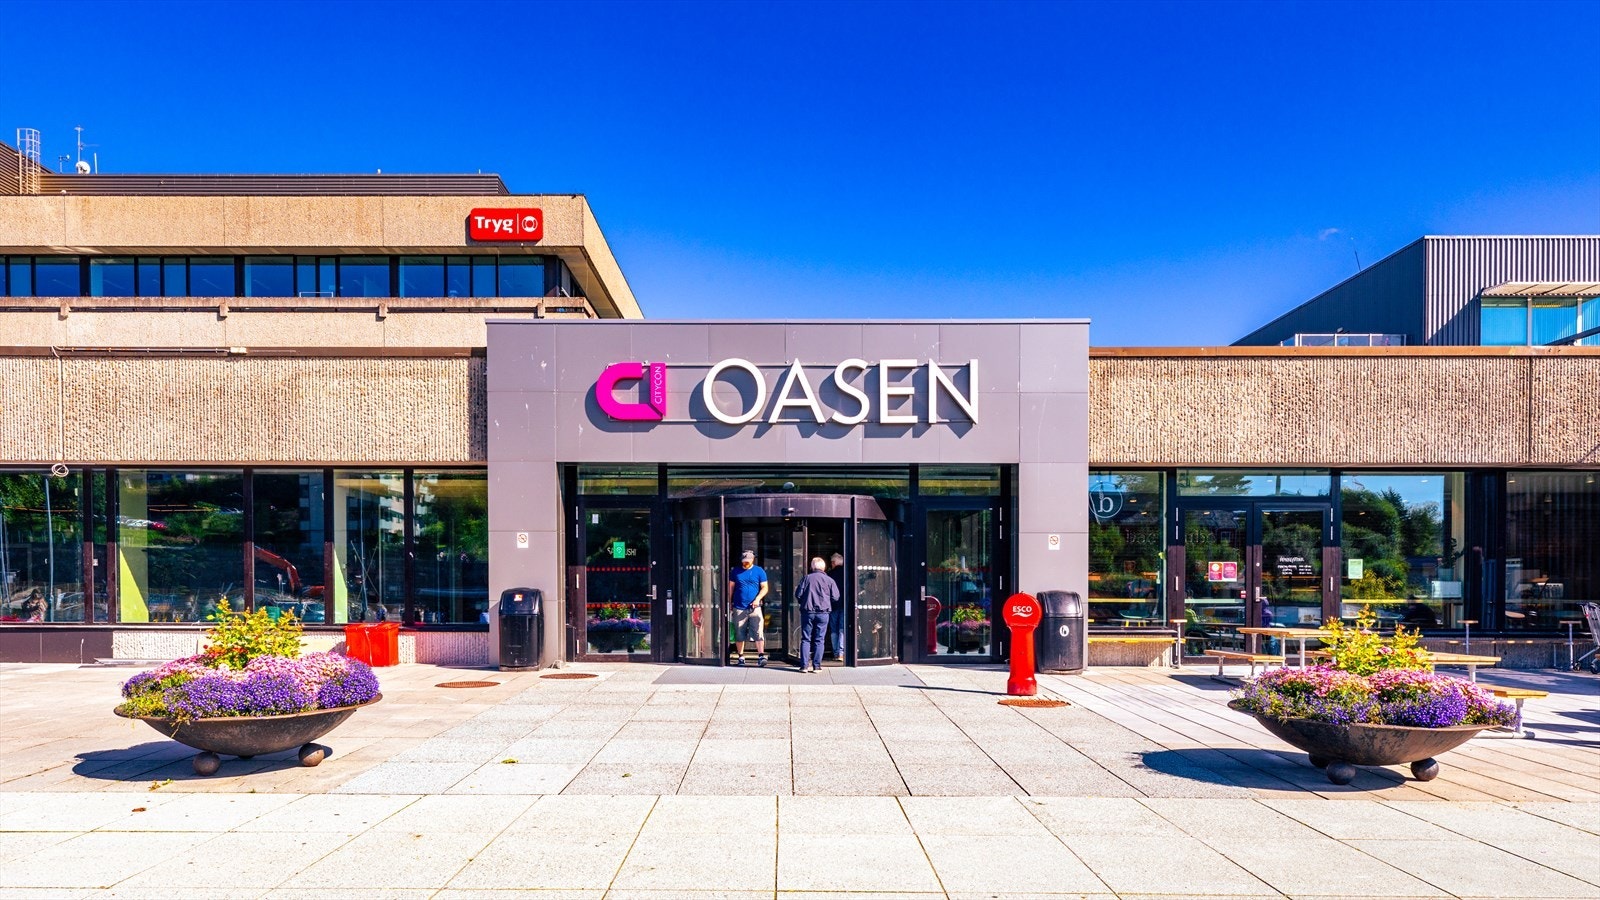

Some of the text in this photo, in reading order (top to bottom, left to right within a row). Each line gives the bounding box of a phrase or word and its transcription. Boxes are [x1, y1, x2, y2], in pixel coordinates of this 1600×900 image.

[474, 216, 514, 234] Tryg
[654, 366, 663, 405] CITYCON
[702, 358, 979, 425] OASEN
[1012, 605, 1033, 613] ESCO
